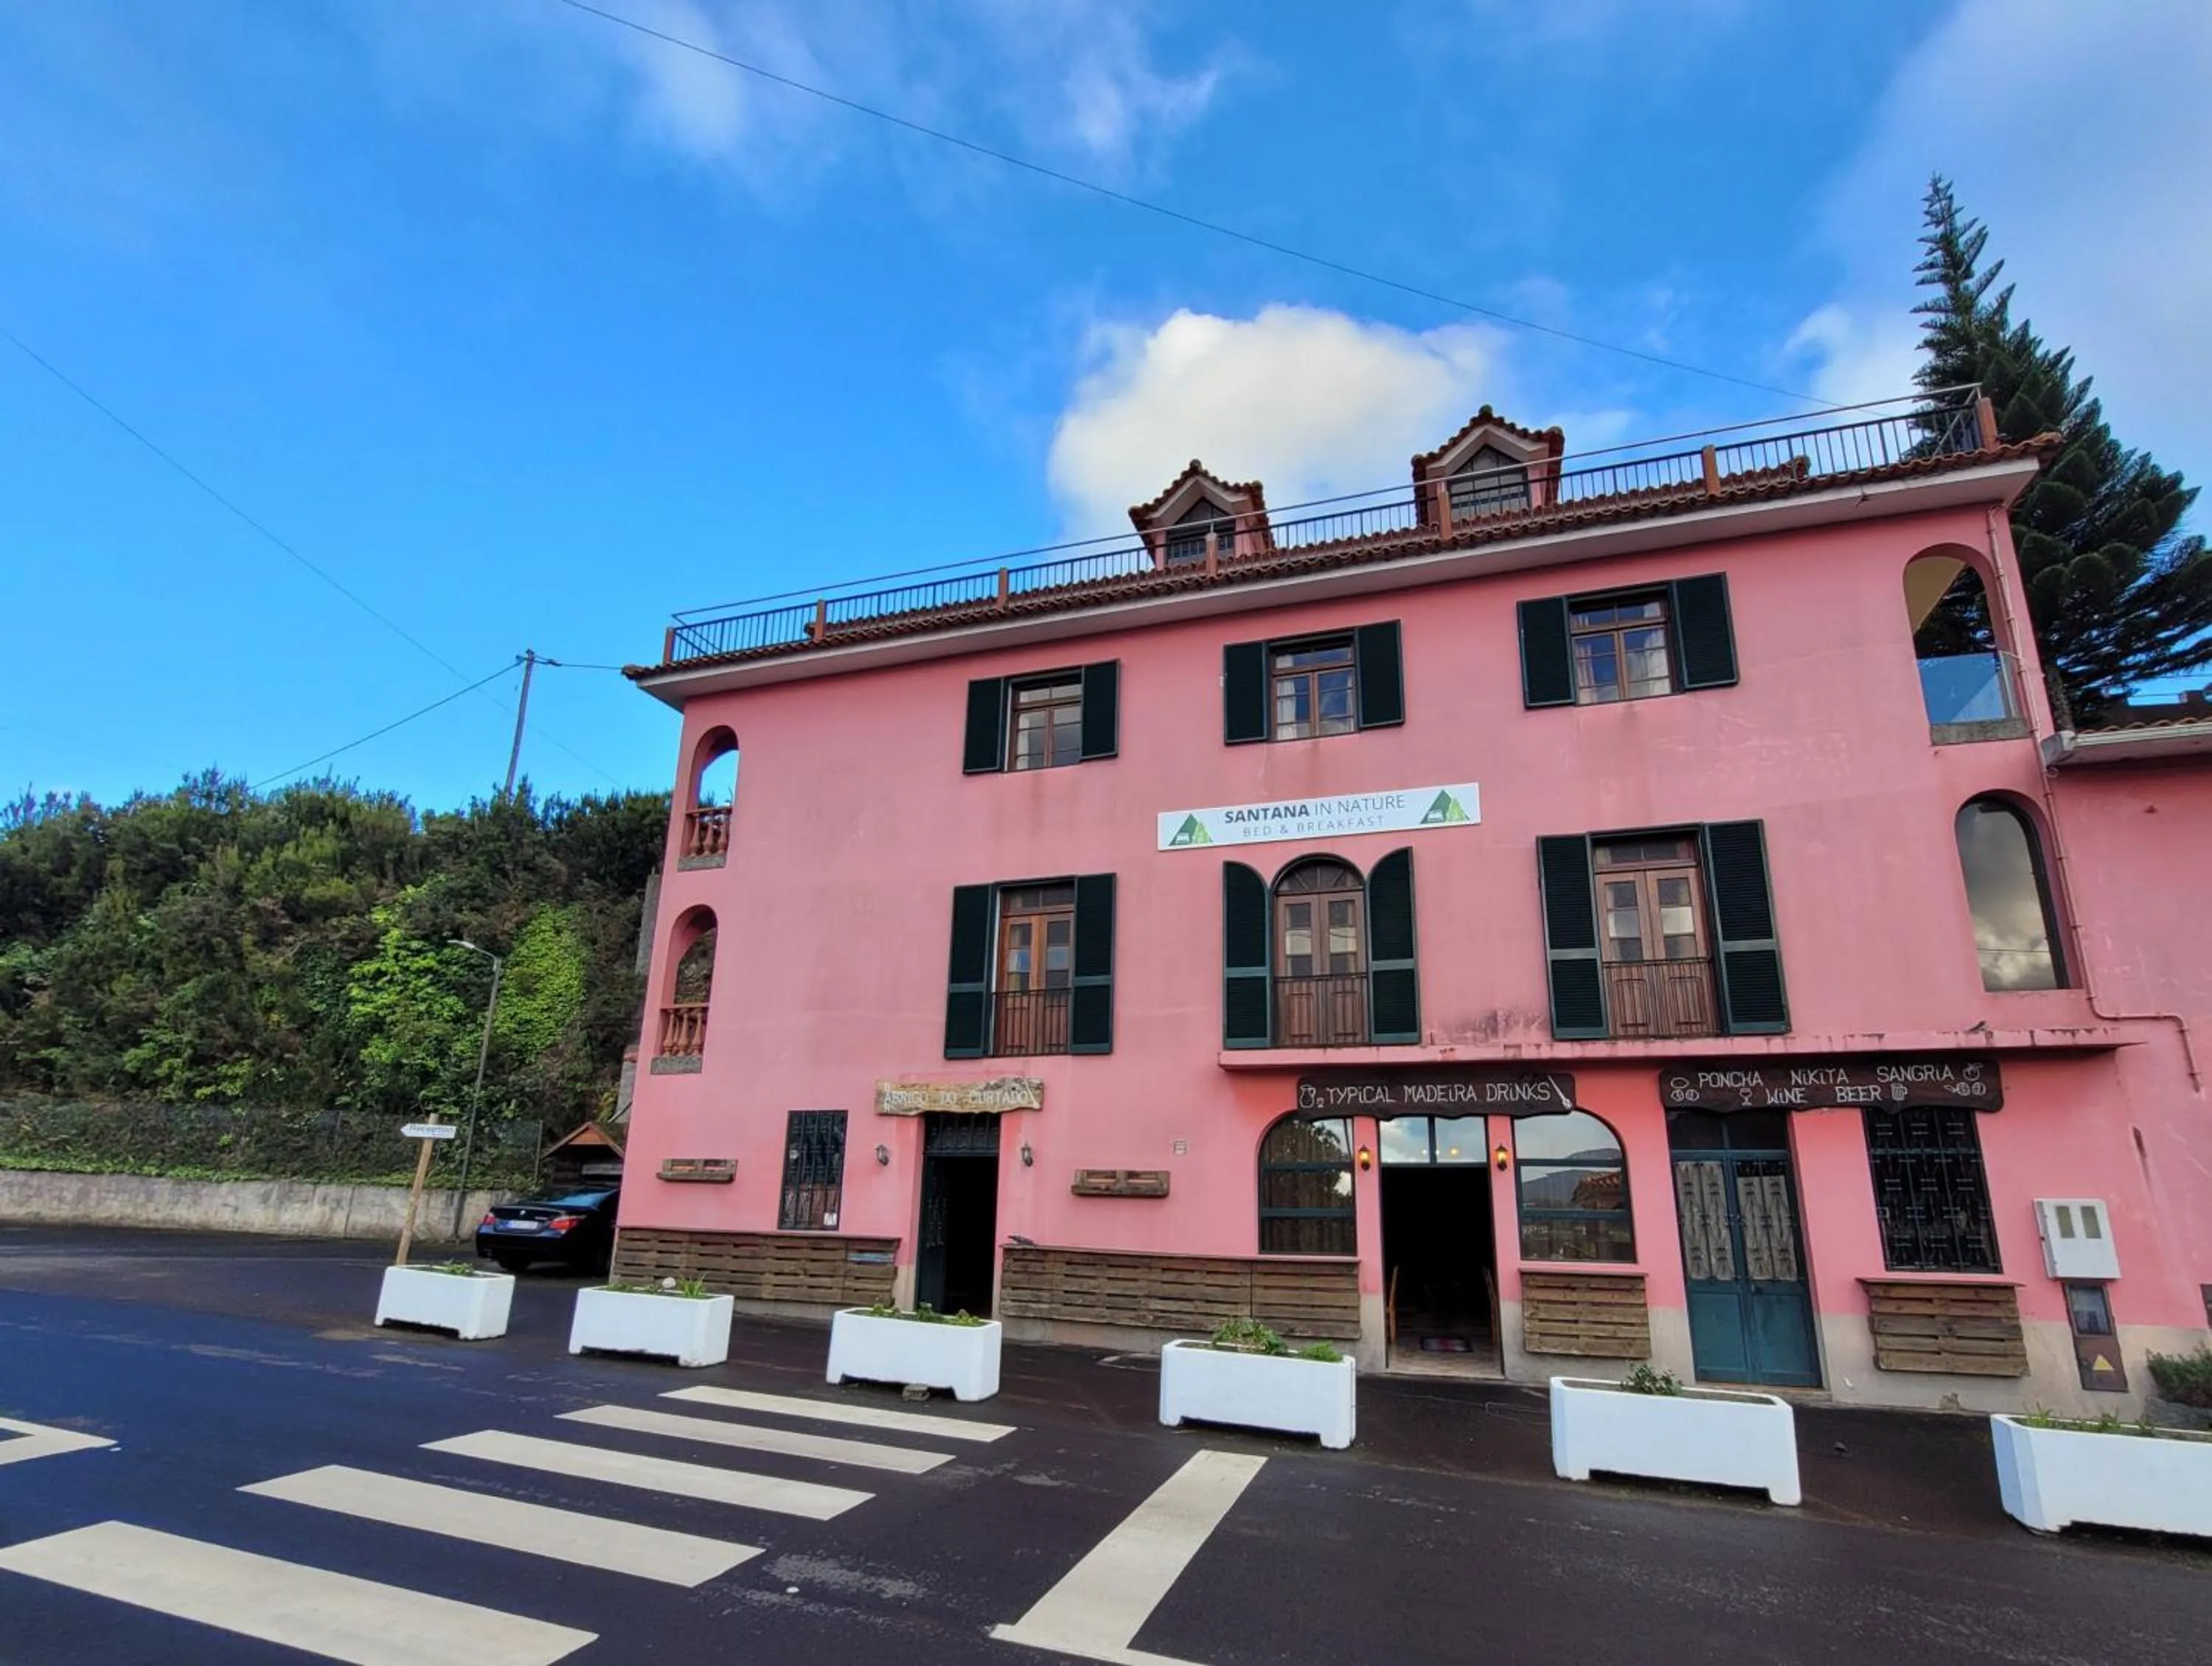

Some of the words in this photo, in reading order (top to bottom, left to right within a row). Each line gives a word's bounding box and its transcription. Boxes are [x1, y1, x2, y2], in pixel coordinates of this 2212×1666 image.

[1225, 804, 1310, 823] SANTANA
[1315, 801, 1331, 816] IN
[1338, 795, 1405, 813] NATURE
[1243, 826, 1272, 837] BED
[1279, 824, 1288, 834] &
[1298, 815, 1385, 833] BREAKFAST
[1698, 1070, 1764, 1089] PONCHA
[941, 1091, 957, 1105] DO
[1835, 1084, 1882, 1104] BEER
